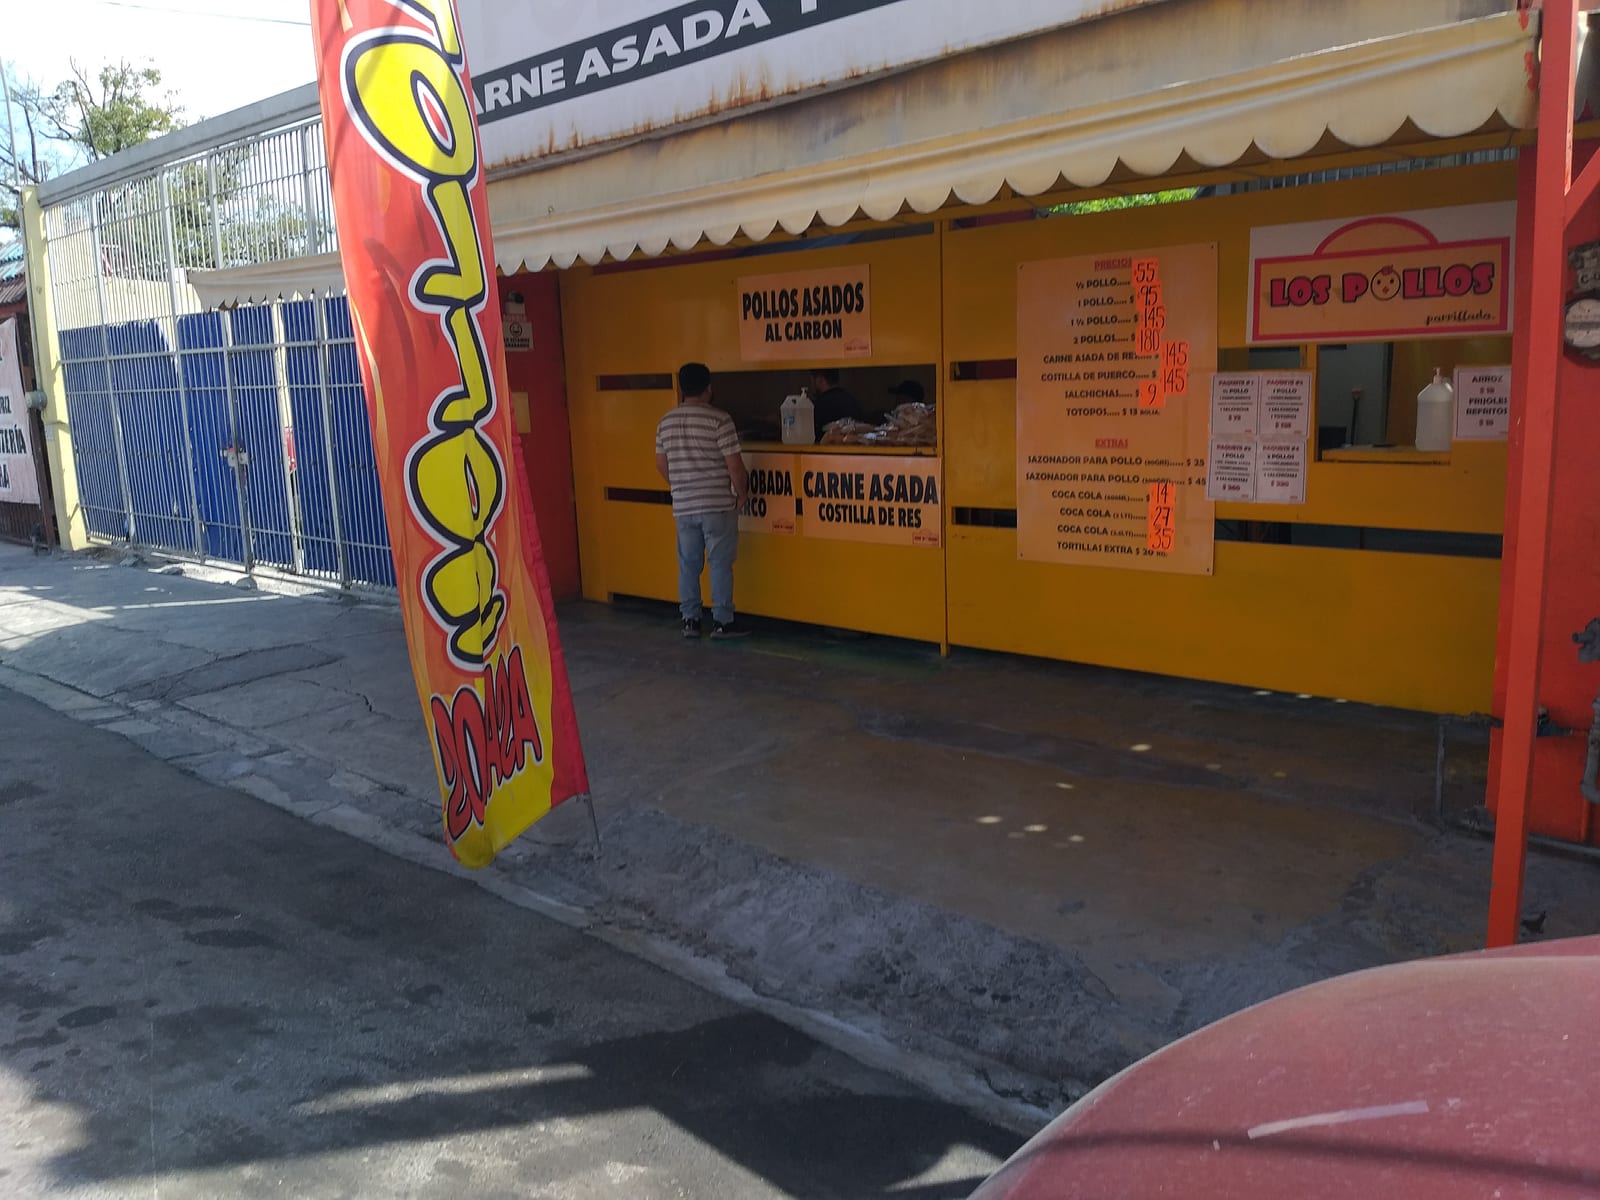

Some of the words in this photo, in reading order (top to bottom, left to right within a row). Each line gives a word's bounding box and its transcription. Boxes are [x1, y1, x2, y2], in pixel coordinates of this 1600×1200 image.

[576, 0, 772, 86] ASADA
[742, 288, 799, 320] POLLOS
[802, 282, 865, 317] ASADOS
[1270, 275, 1331, 307] LOS
[1144, 306, 1165, 328] 145
[765, 323, 782, 342] AL
[785, 319, 842, 341] CARBON
[1140, 330, 1160, 352] 180
[1043, 354, 1073, 364] CARNE
[1075, 353, 1104, 363] ASADA
[1107, 353, 1120, 361] DE
[1166, 342, 1187, 367] 145
[1041, 373, 1081, 382] COSTILLA
[1083, 372, 1095, 380] DE
[1163, 369, 1185, 393] 145
[1472, 375, 1503, 383] ARROZ
[1148, 384, 1157, 405] 9
[1095, 438, 1129, 449] EXTRAS
[1028, 456, 1081, 465] SAZONADOR
[1083, 456, 1108, 465] PARA
[1110, 456, 1142, 466] POLLO
[1186, 458, 1191, 467] $
[747, 469, 792, 496] OBADA
[803, 471, 865, 500] CARNE
[870, 474, 939, 505] ASADA
[1026, 472, 1079, 481] SAZONADOR
[1081, 473, 1105, 482] PARA
[1108, 474, 1140, 483] POLLO
[1188, 476, 1192, 486] $
[1051, 490, 1076, 499] COCA
[1078, 491, 1103, 500] COLA
[818, 503, 876, 525] COSTILLA
[878, 506, 894, 527] DE
[898, 508, 922, 528] RES
[1059, 507, 1084, 516] COCA
[1086, 509, 1111, 518] COLA
[1153, 506, 1171, 526] 27
[1057, 524, 1082, 534] COCA
[1083, 525, 1108, 535] COLA
[1151, 527, 1172, 549] 35
[1057, 541, 1102, 552] TORTILLAS
[1104, 545, 1133, 555] EXTRA
[1135, 547, 1140, 556] $
